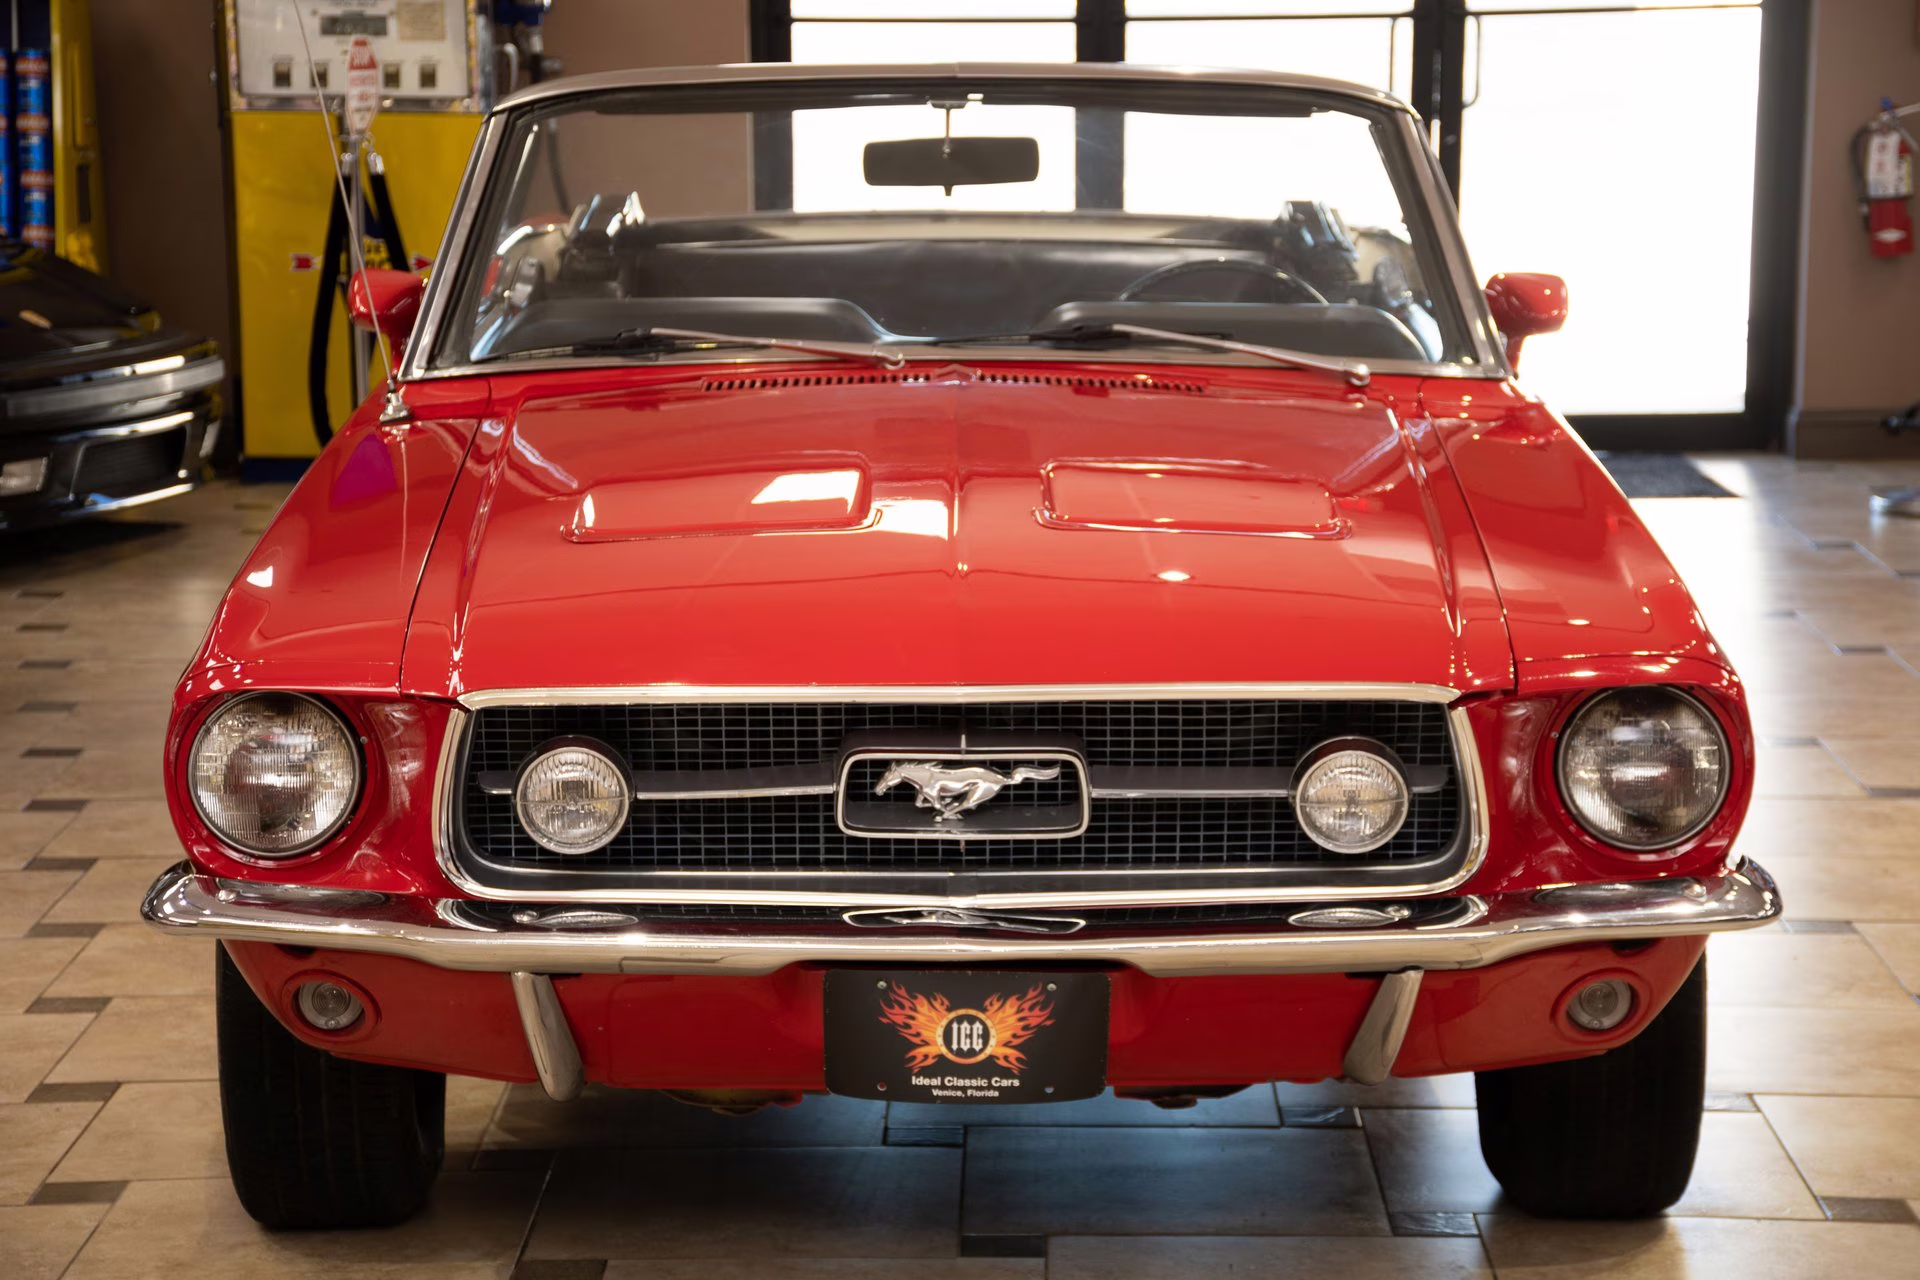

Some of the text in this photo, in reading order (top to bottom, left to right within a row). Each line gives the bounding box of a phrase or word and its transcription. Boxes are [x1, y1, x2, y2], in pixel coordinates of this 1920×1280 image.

[951, 1020, 983, 1052] ICC
[911, 1075, 1020, 1087] Ideal Classic Cars
[931, 1088, 999, 1097] Venice, Florida
